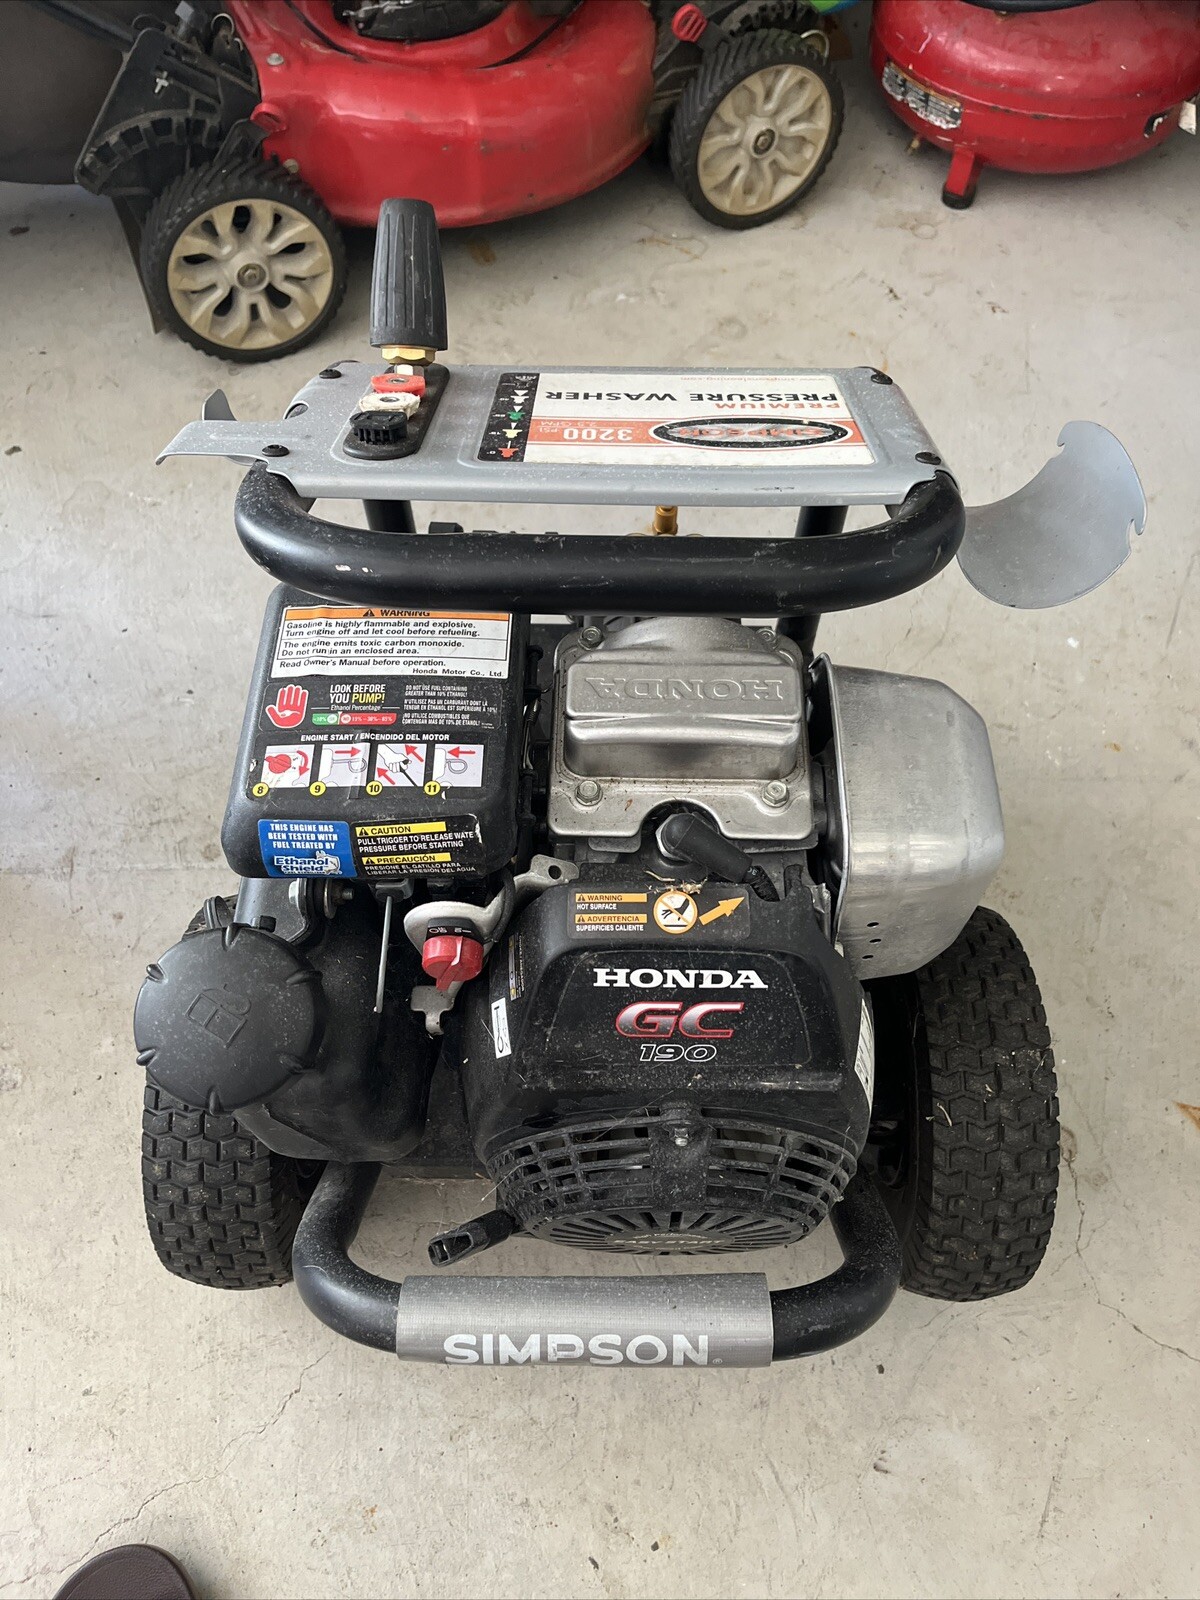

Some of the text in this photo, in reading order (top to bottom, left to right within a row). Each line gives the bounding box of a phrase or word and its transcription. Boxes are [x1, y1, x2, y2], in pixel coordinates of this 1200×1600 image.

[545, 391, 838, 402] PRESSURE WASHER
[562, 428, 633, 441] 3200
[380, 609, 430, 617] WARNING
[287, 621, 322, 629] Gasoline
[432, 621, 476, 629] explosive.
[285, 629, 304, 637] Turn
[306, 628, 336, 636] engine
[438, 629, 480, 637] refueling.
[403, 659, 446, 667] operation.
[329, 684, 386, 693] LOOK BEFORE
[585, 677, 784, 701] HONDA
[329, 693, 386, 703] YOU PUMP!
[351, 704, 381, 712] Percentage
[300, 734, 329, 742] ENGINE
[360, 732, 404, 741] ENCENDIDO
[256, 786, 264, 794] 8
[314, 785, 321, 793] 9
[368, 785, 380, 793] 10
[427, 784, 437, 793] 11
[270, 823, 334, 832] THIS ENGINE HAS
[371, 826, 411, 835] CAUTION
[267, 832, 287, 840] BEEN
[288, 833, 316, 841] TESTED
[377, 836, 409, 845] TRIGGER
[410, 835, 419, 843] TO
[421, 833, 453, 842] RELEASE
[454, 831, 474, 839] WATE
[273, 841, 290, 849] FUEL
[291, 841, 323, 849] TREATED
[359, 840, 464, 853] PRESSURE BEFORE STARTING
[275, 857, 329, 865] Ethanol
[376, 854, 436, 864] PRECAUCIÓN
[593, 968, 769, 989] HONDA
[615, 1001, 745, 1039] GC
[639, 1043, 717, 1062] 190
[443, 1333, 710, 1366] SIMPSON
